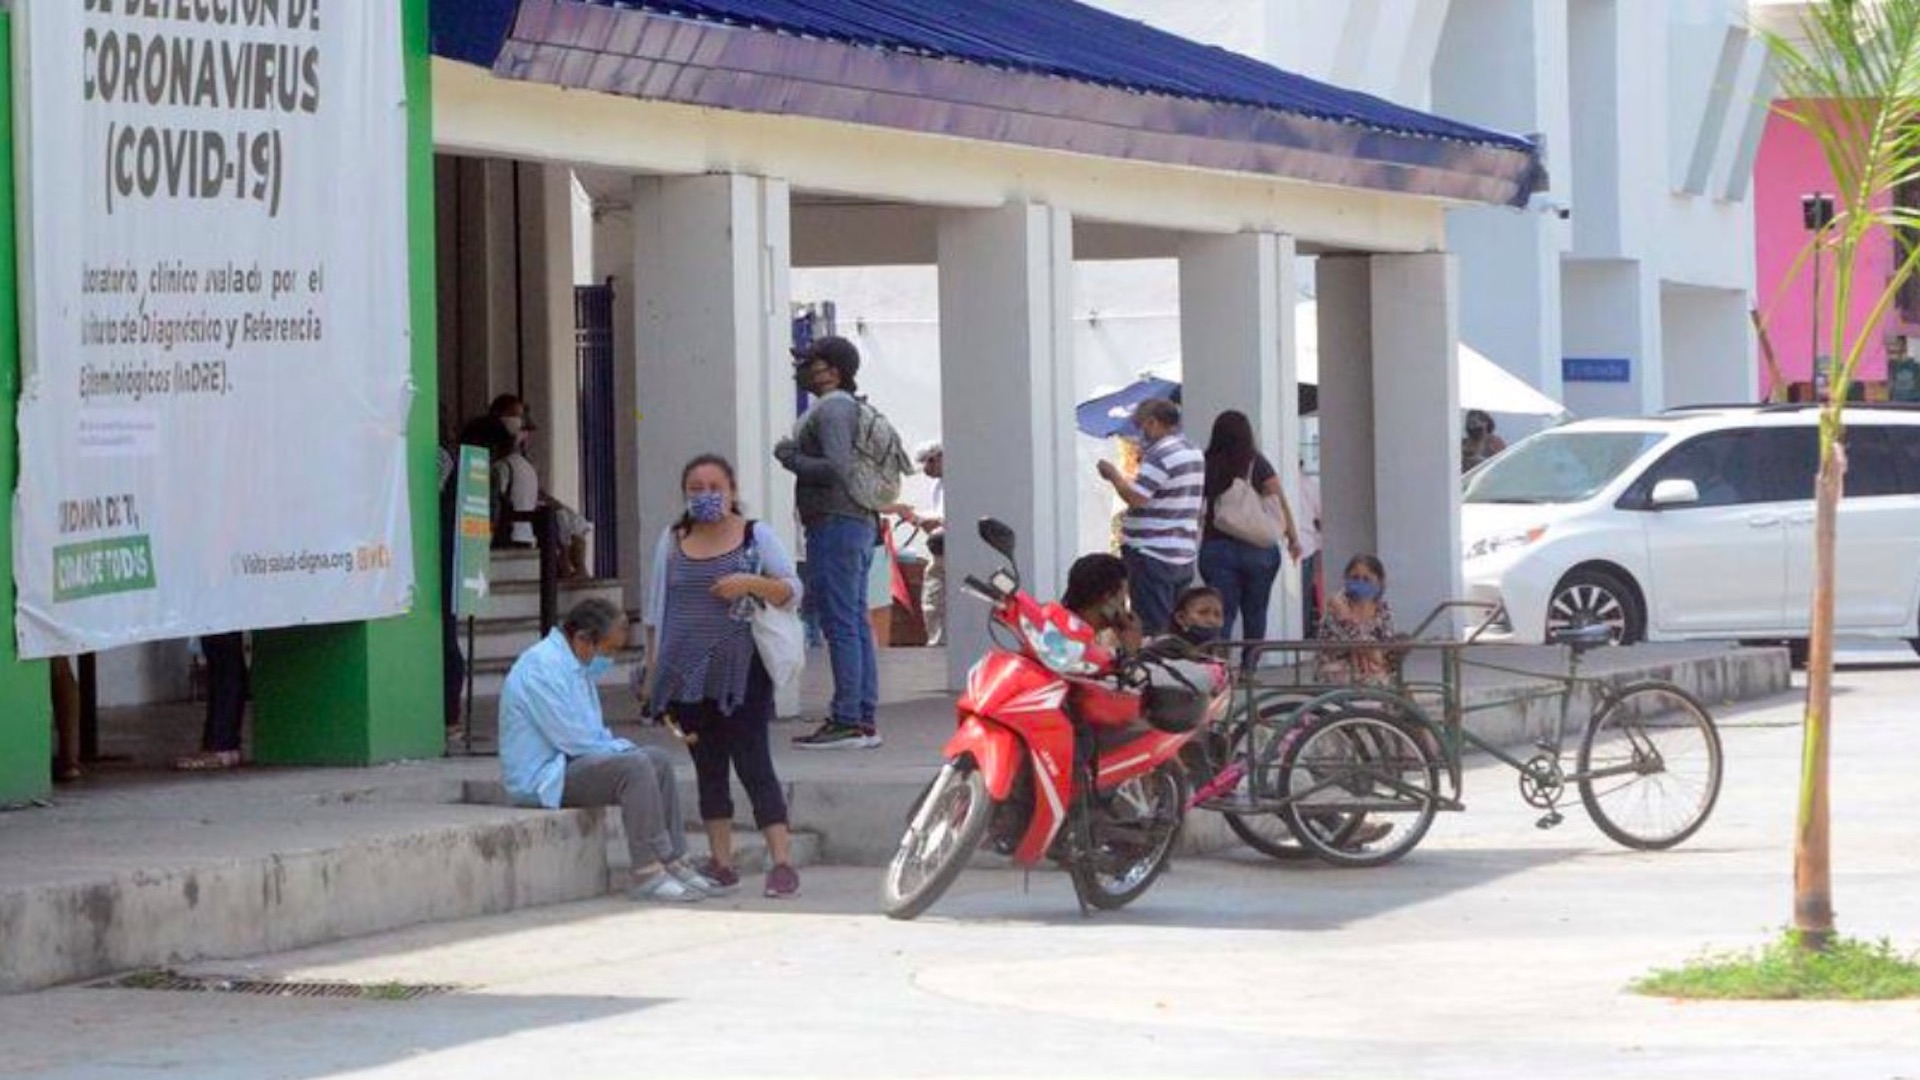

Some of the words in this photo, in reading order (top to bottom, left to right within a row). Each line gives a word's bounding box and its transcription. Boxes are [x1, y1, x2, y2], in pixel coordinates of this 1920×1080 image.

[84, 28, 320, 113] CORONAVIRUS
[106, 121, 283, 217] (COVID-19)
[225, 317, 238, 350] y
